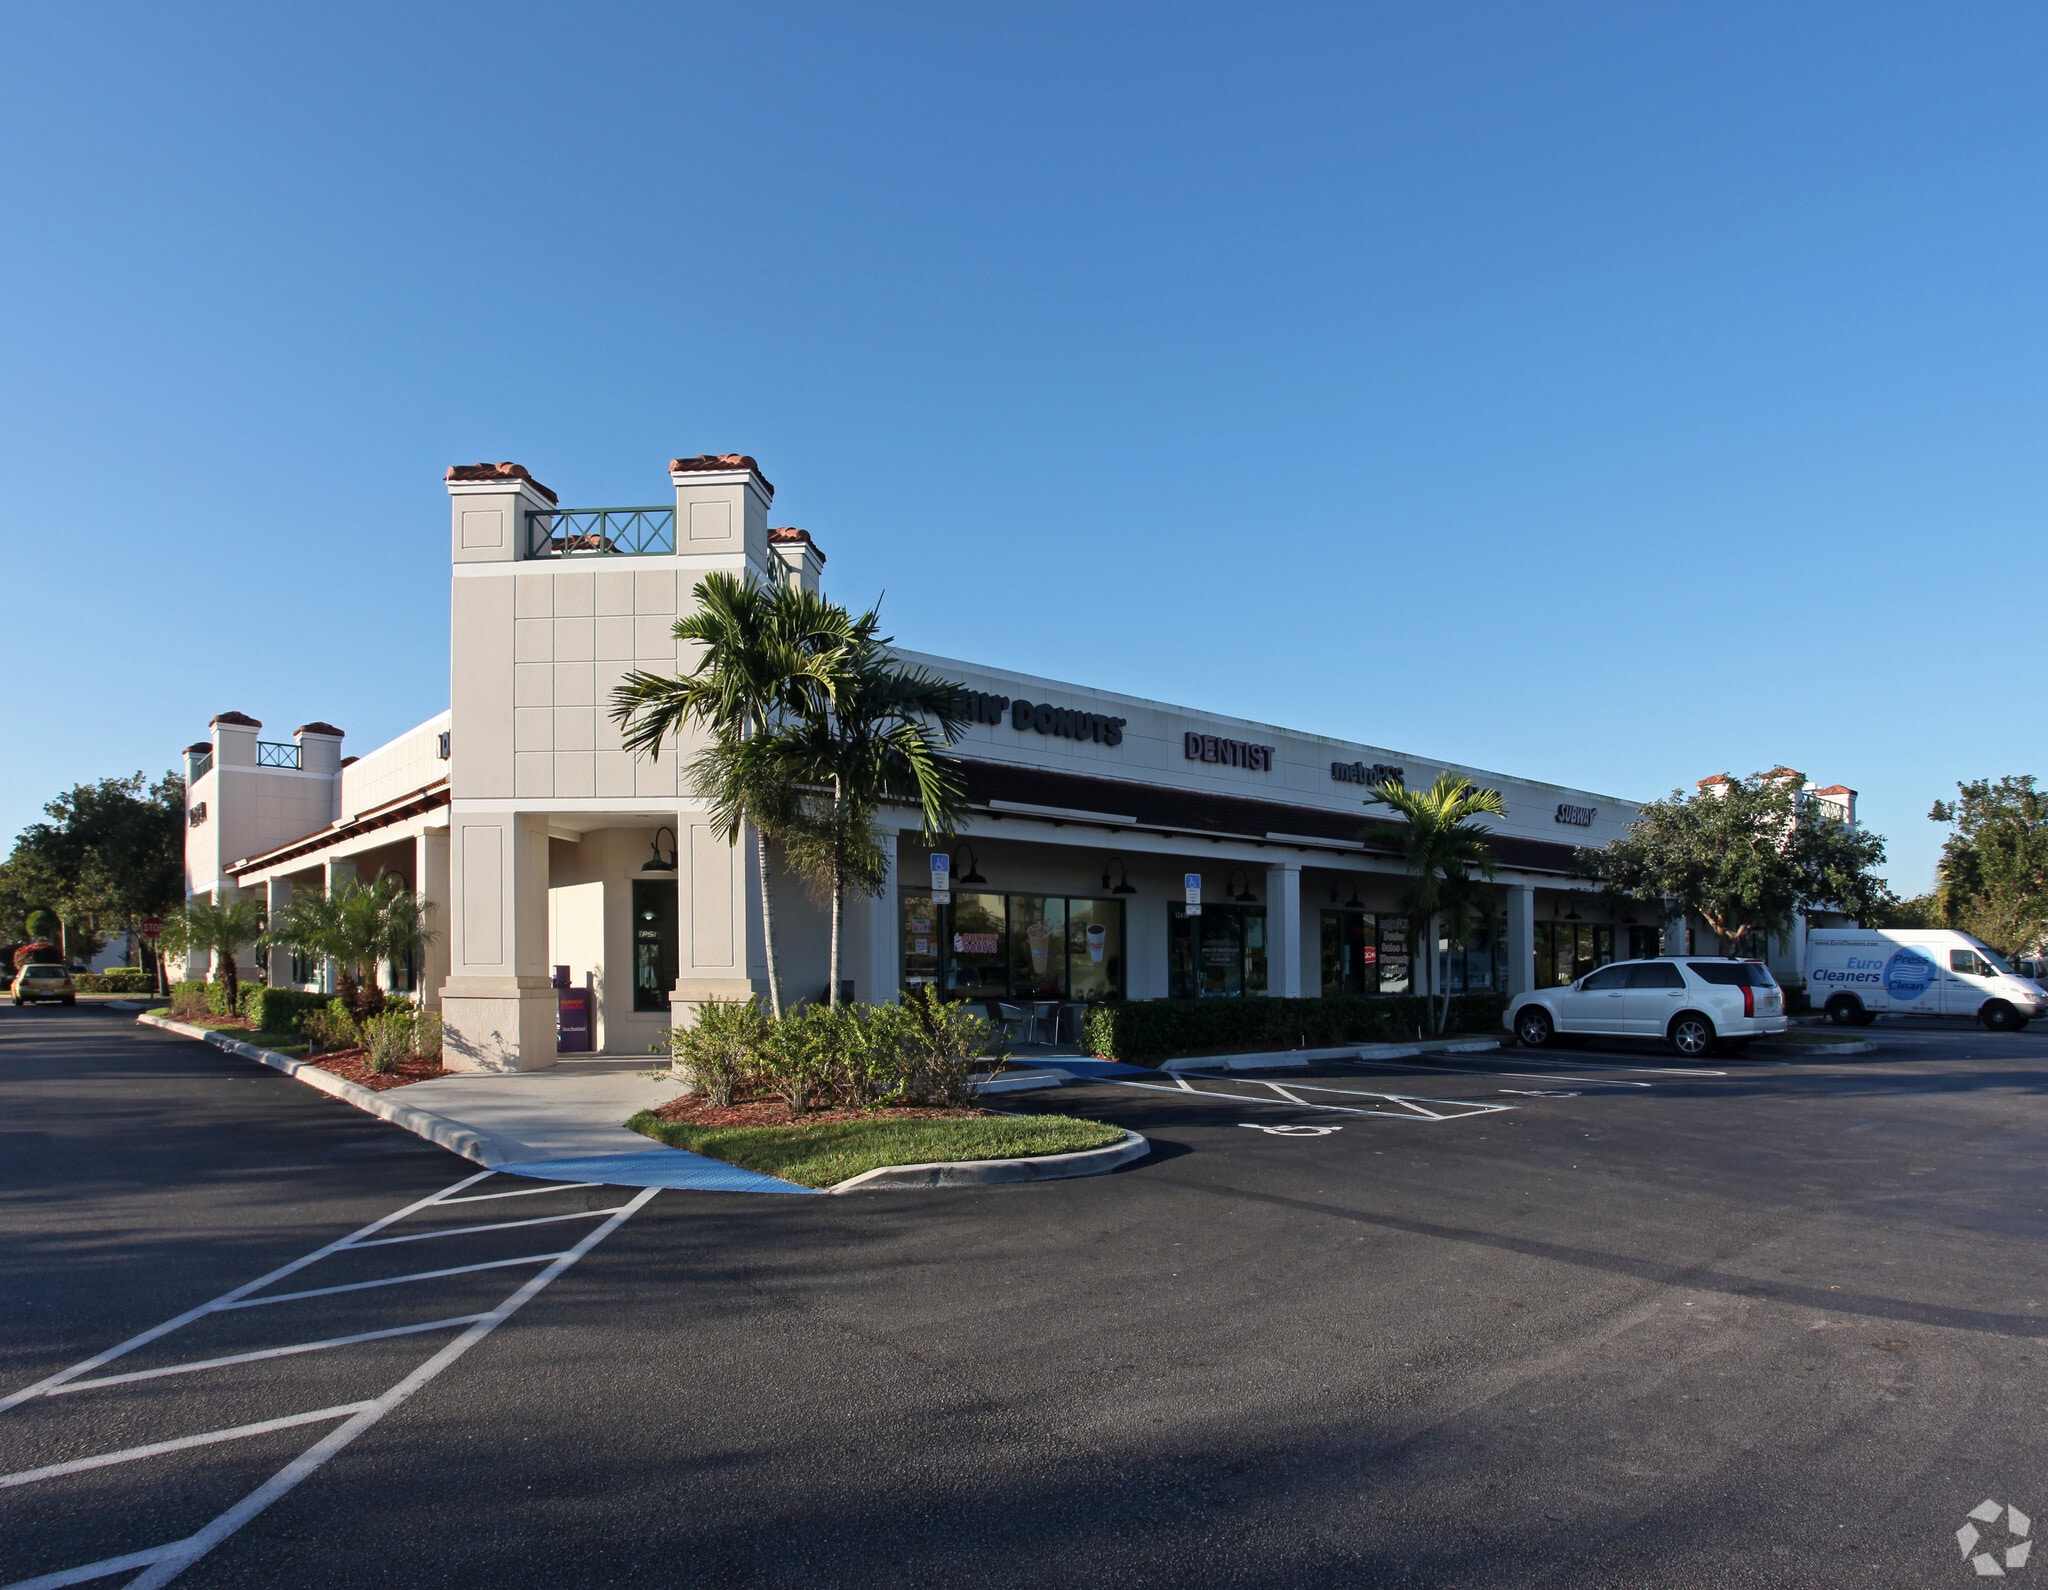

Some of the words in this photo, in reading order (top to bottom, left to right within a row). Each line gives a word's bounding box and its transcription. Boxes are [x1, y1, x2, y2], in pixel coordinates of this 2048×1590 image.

[880, 675, 1010, 726] KIN'
[1012, 699, 1124, 747] DONUTS
[1185, 732, 1275, 772] DENTIST
[1332, 762, 1405, 788] metroPCS
[1555, 804, 1598, 827] SUBWAY
[143, 923, 165, 932] STOP
[963, 932, 999, 943] DUNKIN'
[963, 943, 998, 954] DONUTS
[1846, 957, 1883, 970] Euro
[1894, 954, 1929, 965] Press
[1812, 969, 1881, 983] Cleaners
[1888, 980, 1924, 991] Clean
